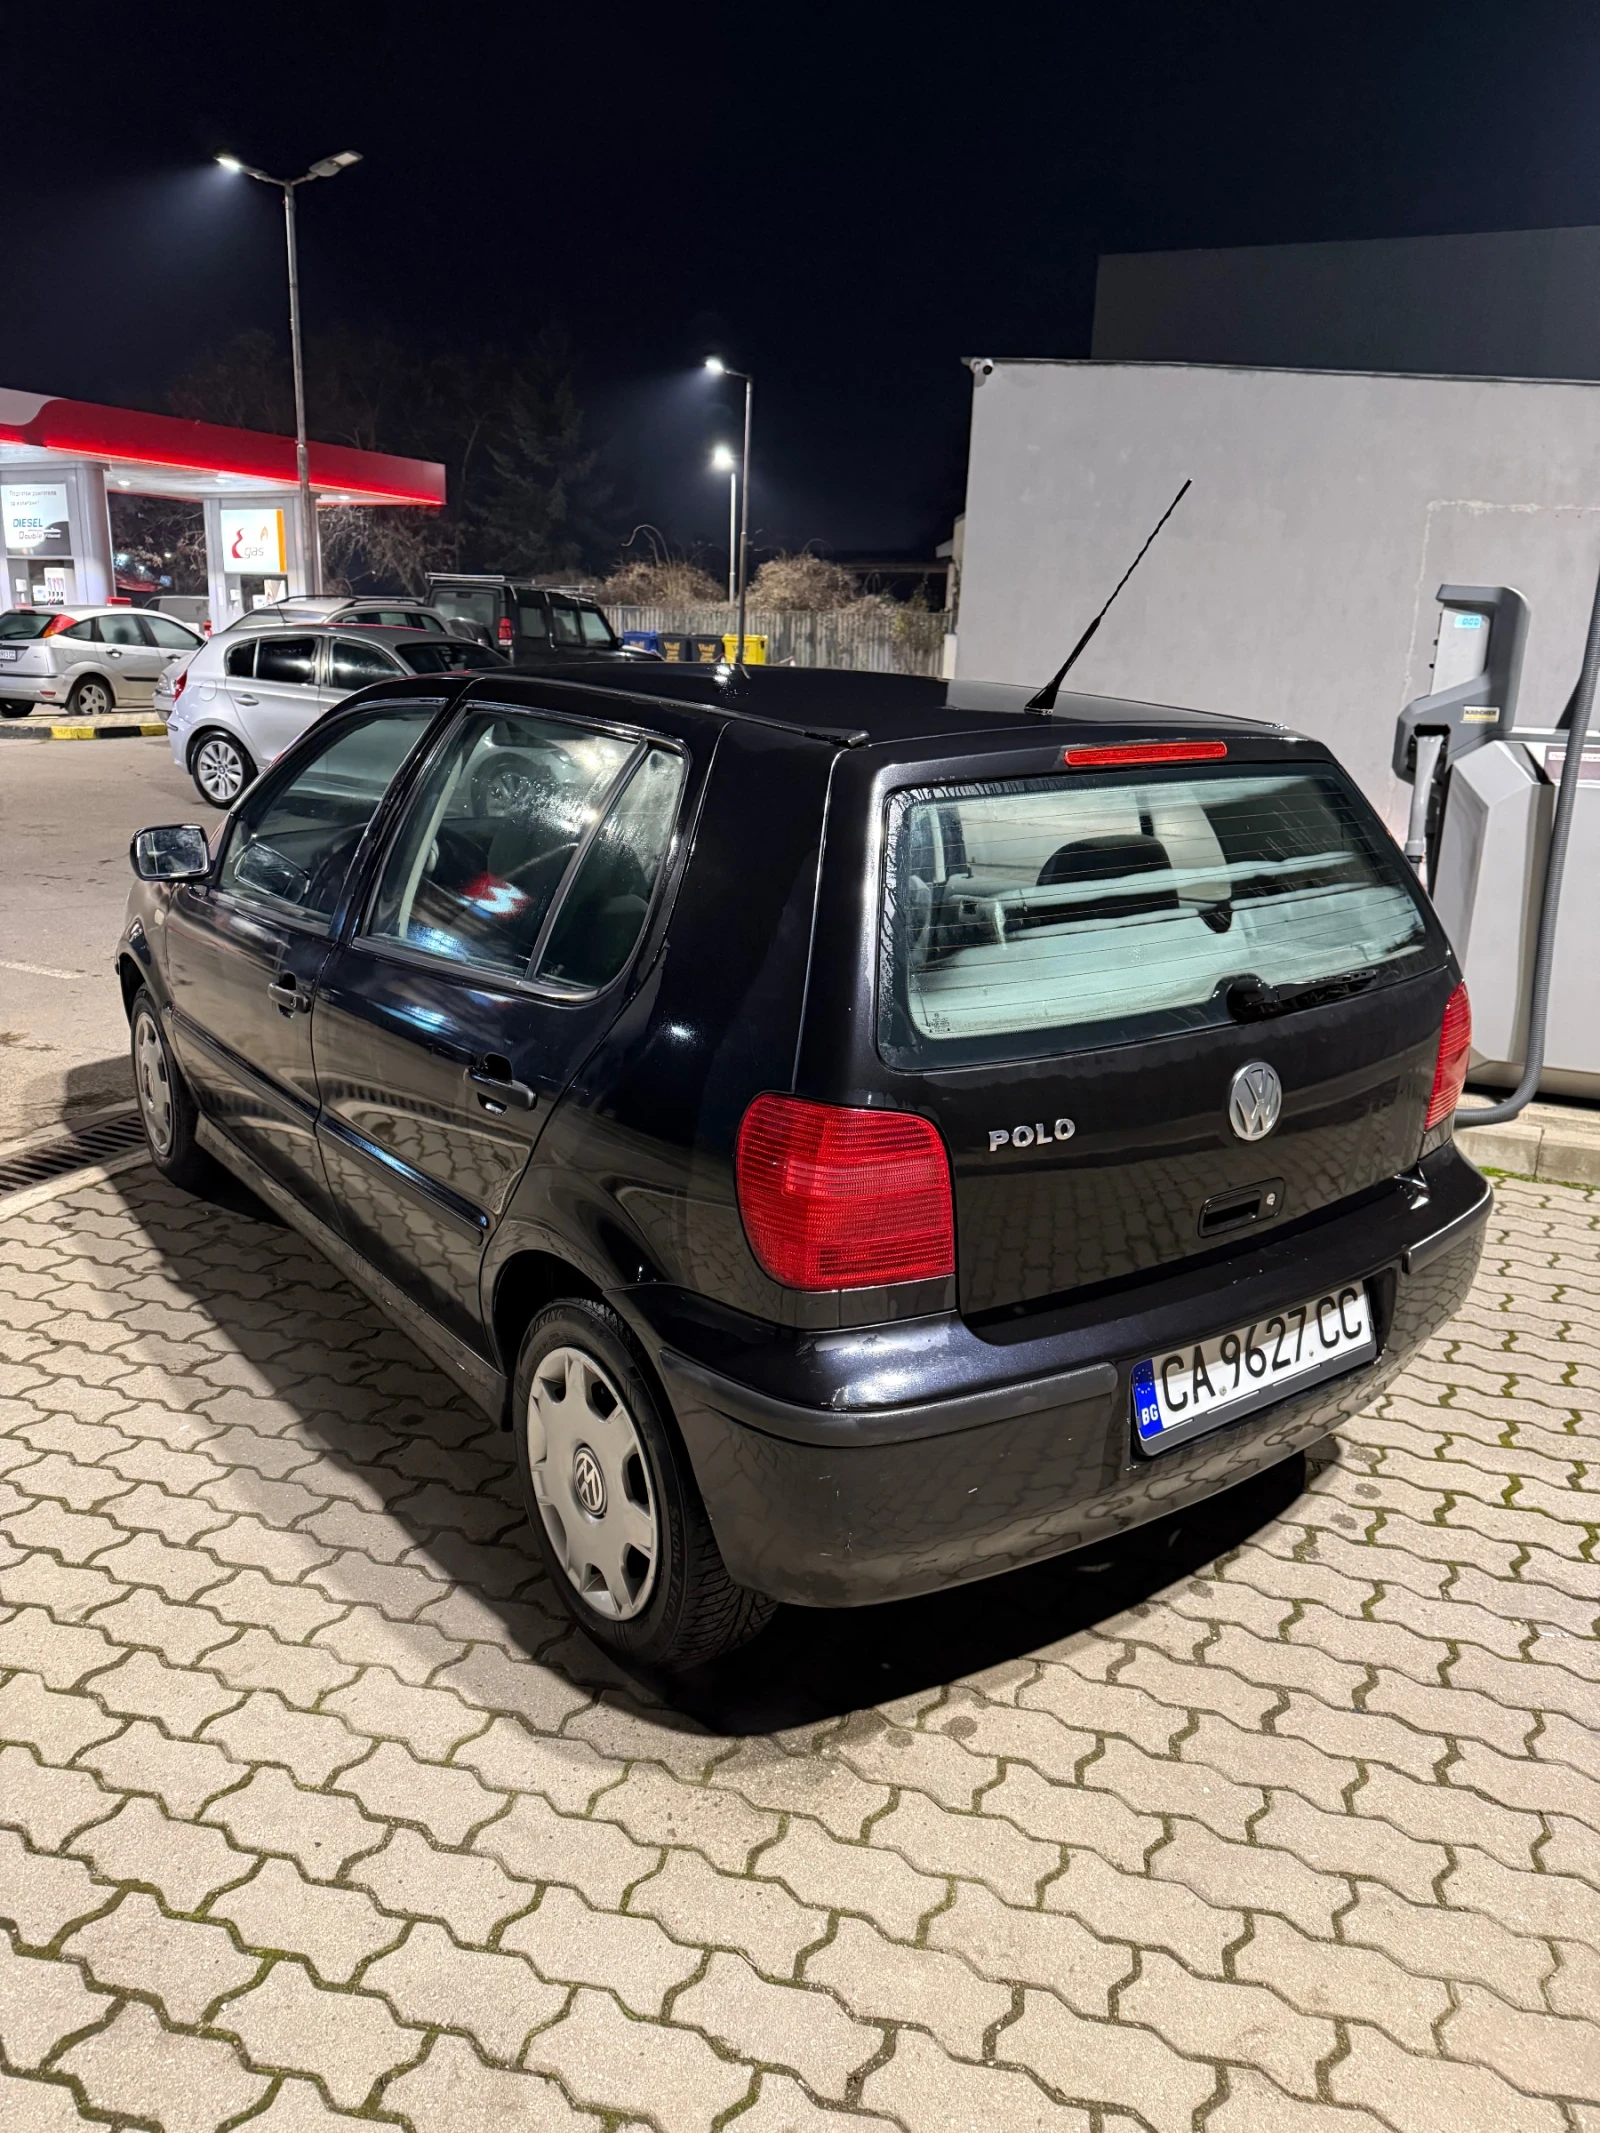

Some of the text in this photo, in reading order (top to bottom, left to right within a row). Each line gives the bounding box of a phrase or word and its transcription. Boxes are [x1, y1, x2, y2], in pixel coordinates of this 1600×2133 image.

[13, 518, 43, 528] DIESEL
[19, 531, 43, 539] Double
[988, 1118, 1076, 1152] POLO
[1161, 1287, 1362, 1412] CA 9627 CC
[1141, 1403, 1159, 1426] BG
